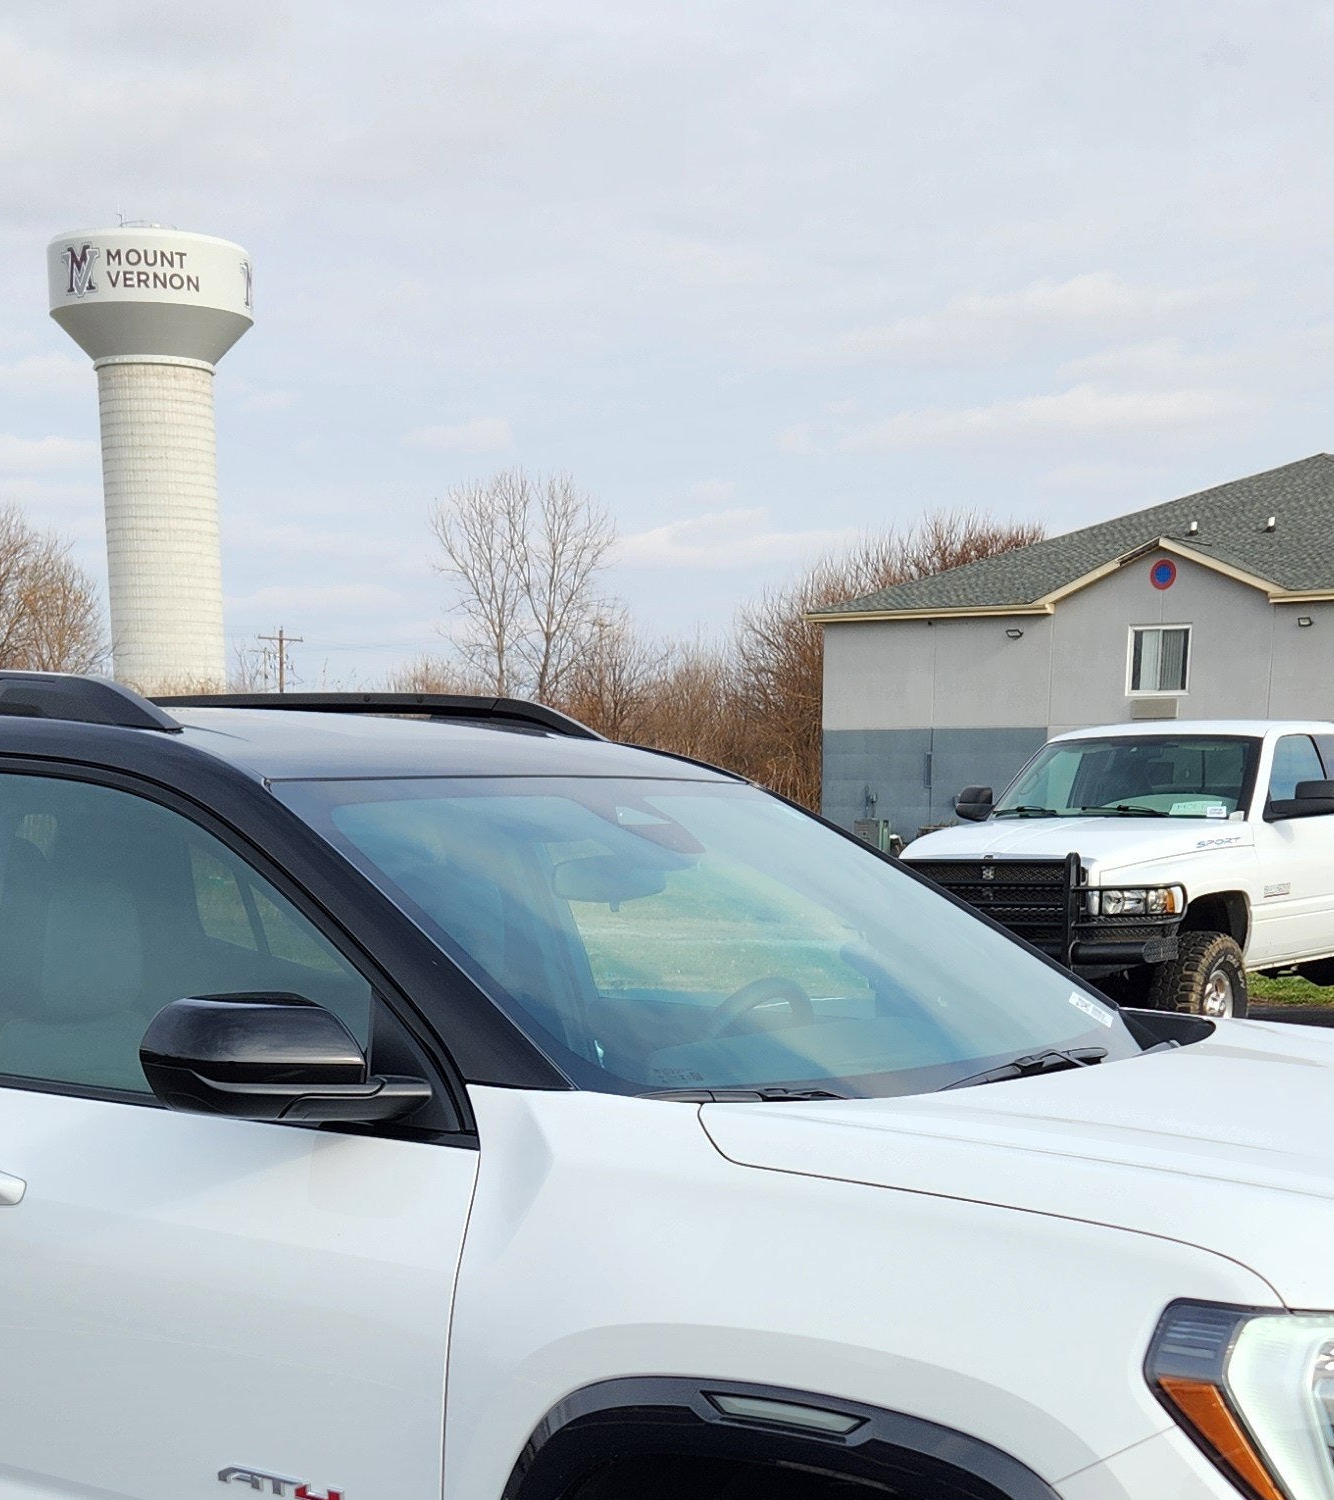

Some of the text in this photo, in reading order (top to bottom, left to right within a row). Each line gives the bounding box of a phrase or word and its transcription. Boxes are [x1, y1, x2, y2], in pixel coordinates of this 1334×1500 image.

[106, 248, 187, 269] MOUNT
[106, 270, 200, 292] VERNON
[1196, 837, 1241, 849] SPORT
